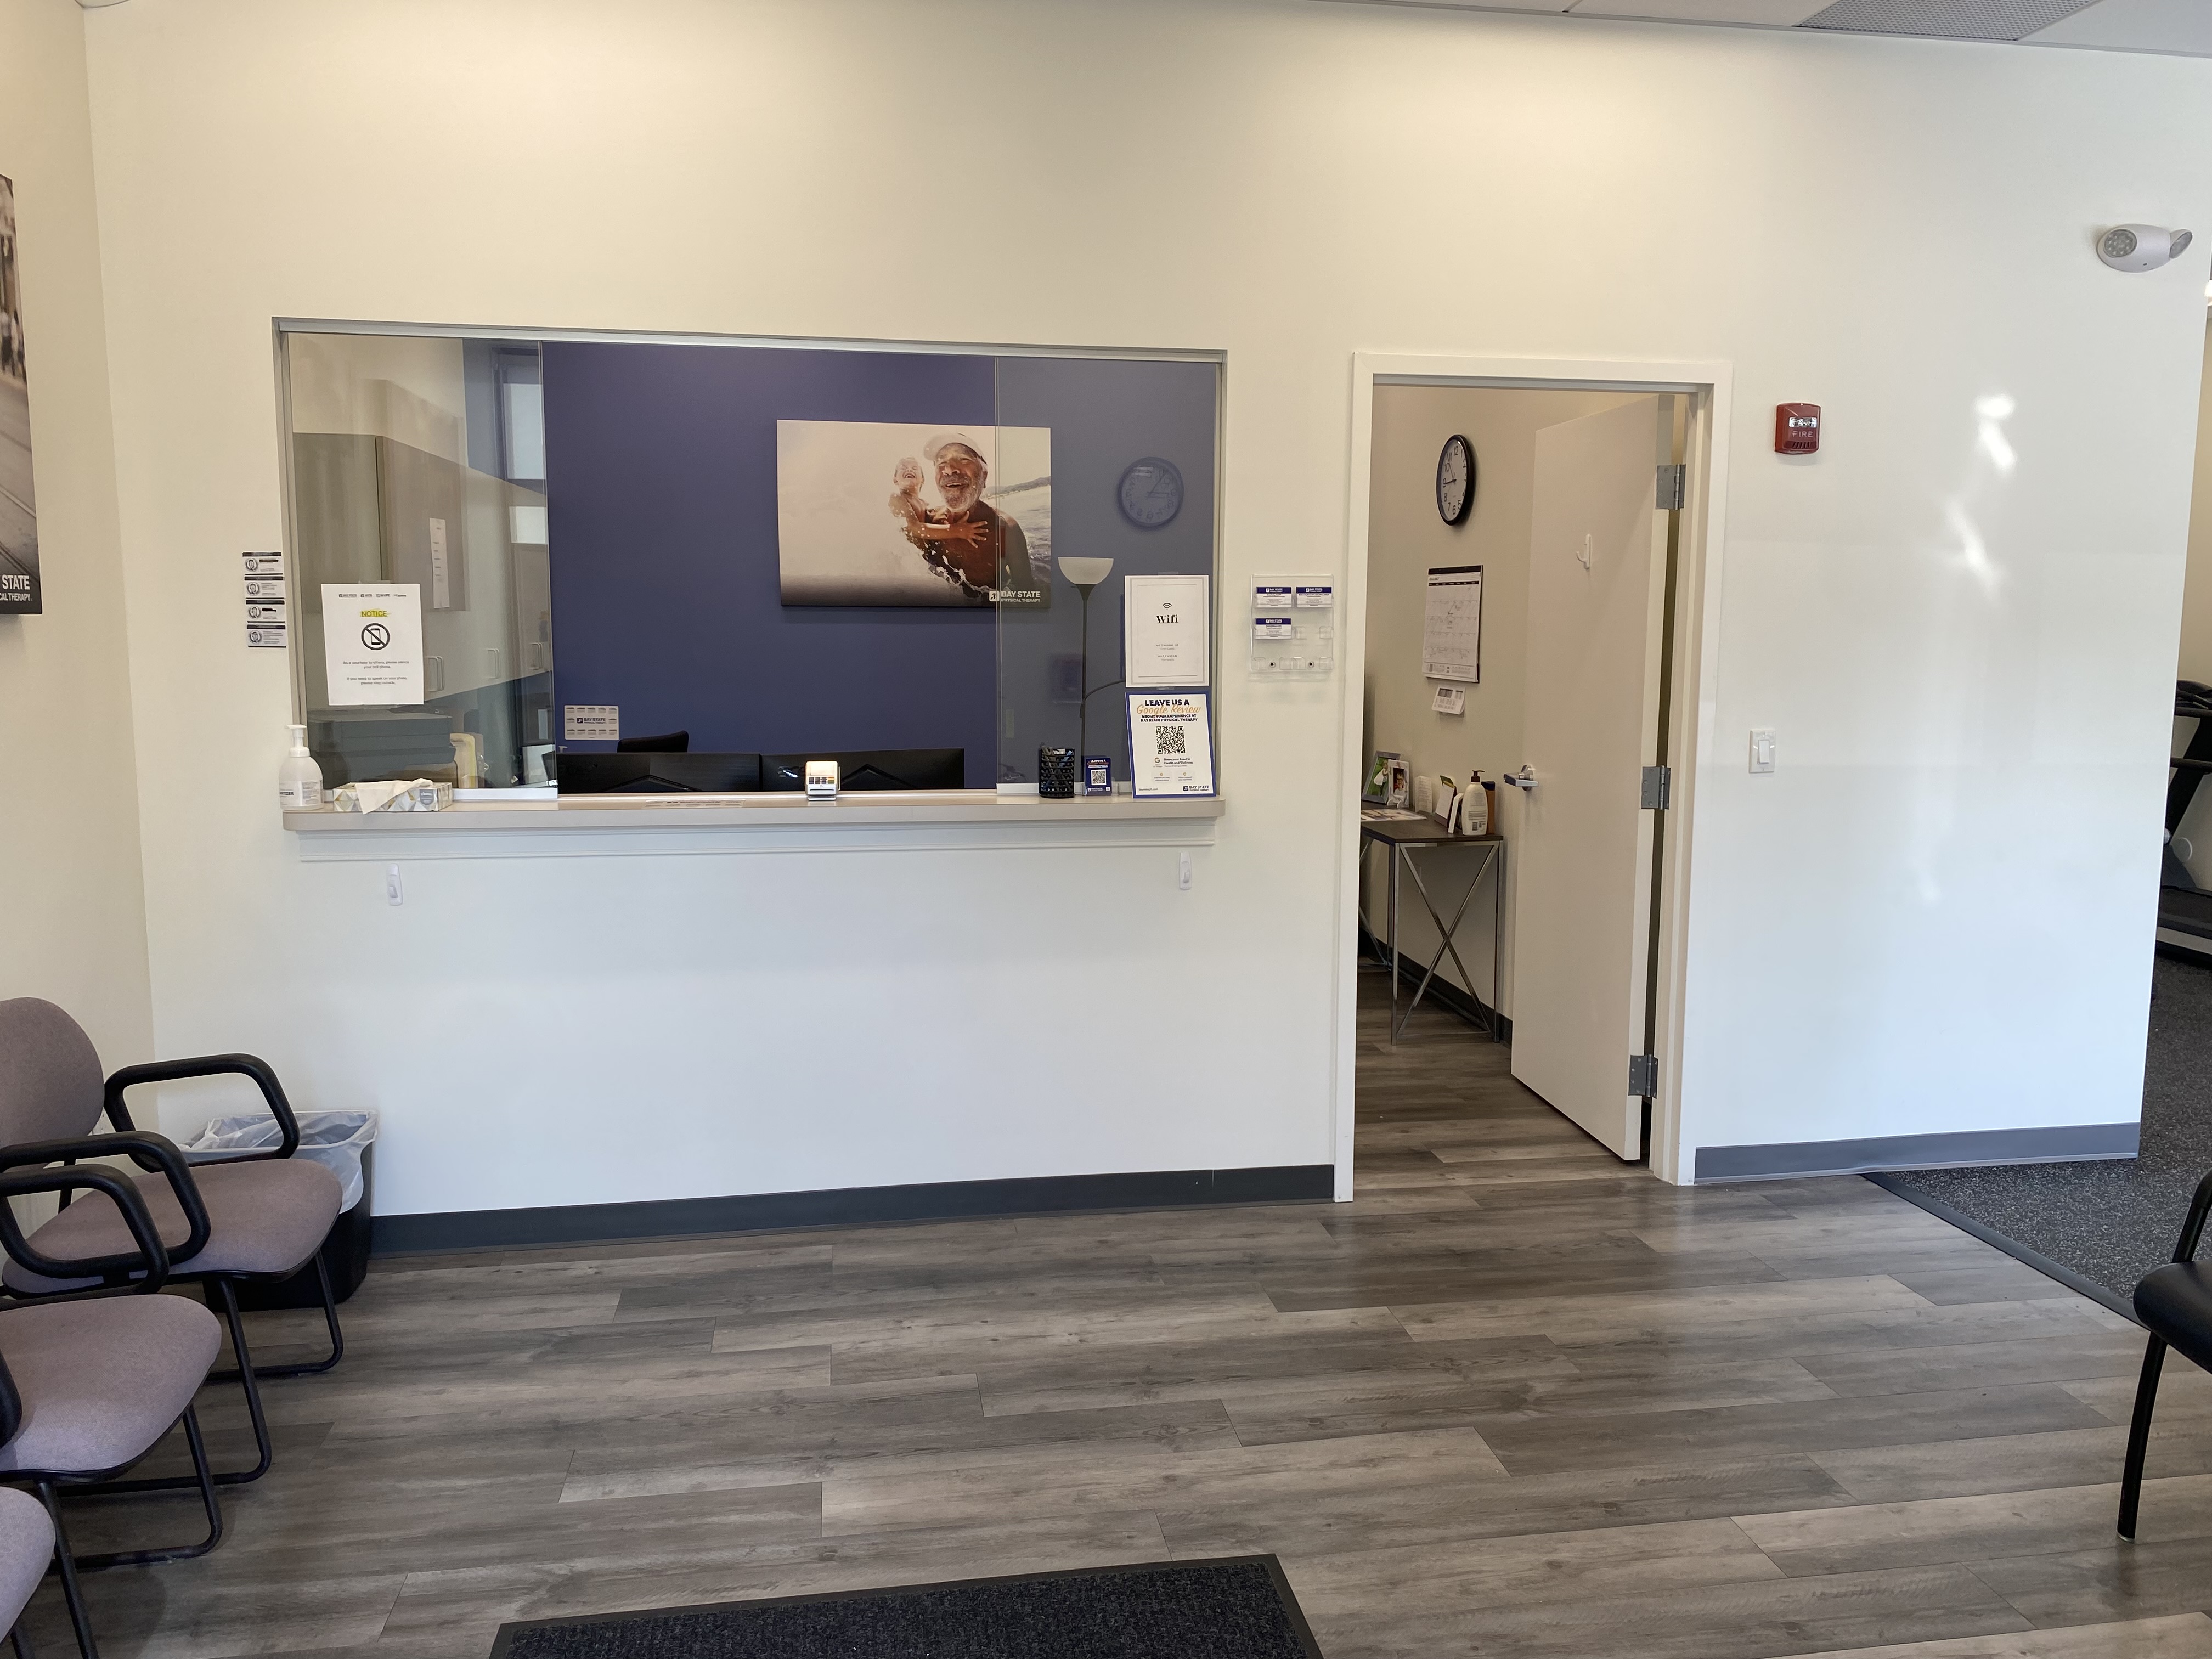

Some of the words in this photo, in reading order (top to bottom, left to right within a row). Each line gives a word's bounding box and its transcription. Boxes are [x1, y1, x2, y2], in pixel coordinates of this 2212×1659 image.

[1454, 446, 1458, 455] 12
[1460, 449, 1463, 458] 1
[1449, 452, 1453, 461] 11
[1444, 463, 1449, 472] 10
[1444, 493, 1447, 502] 8
[1448, 502, 1451, 511] 7
[1452, 505, 1456, 515] 6
[2, 574, 30, 590] STATE
[1156, 614, 1178, 623] Wifi
[1136, 704, 1169, 716] Google
[1170, 704, 1201, 714] Review
